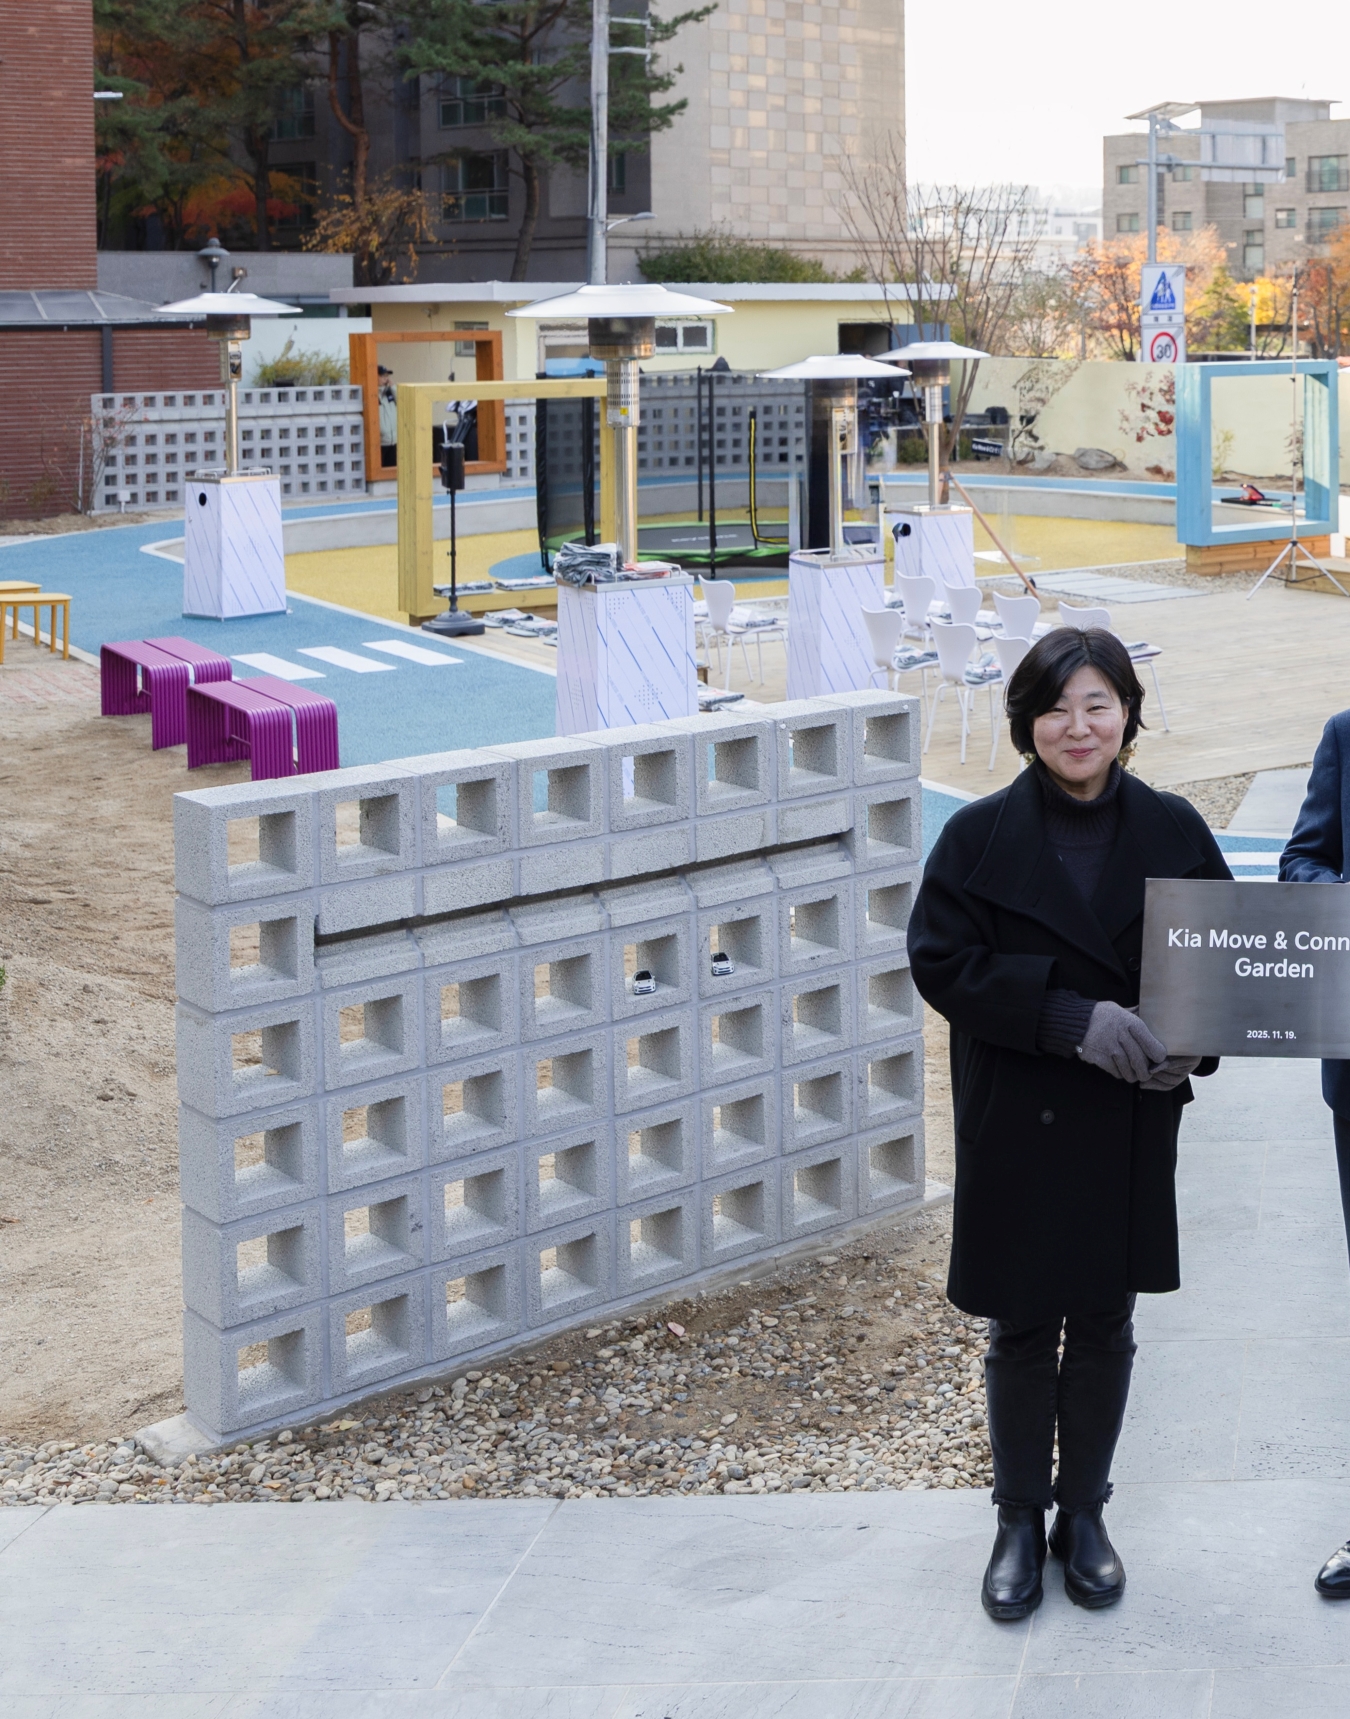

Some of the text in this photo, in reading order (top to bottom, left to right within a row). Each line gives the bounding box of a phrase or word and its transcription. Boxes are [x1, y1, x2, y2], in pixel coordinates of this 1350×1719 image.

[1156, 344, 1172, 360] 30
[1167, 928, 1201, 947] Kia
[1209, 929, 1267, 949] Move
[1273, 931, 1288, 949] &
[1234, 957, 1314, 978] Garden
[1246, 1030, 1297, 1039] 2025. 11. 19.
